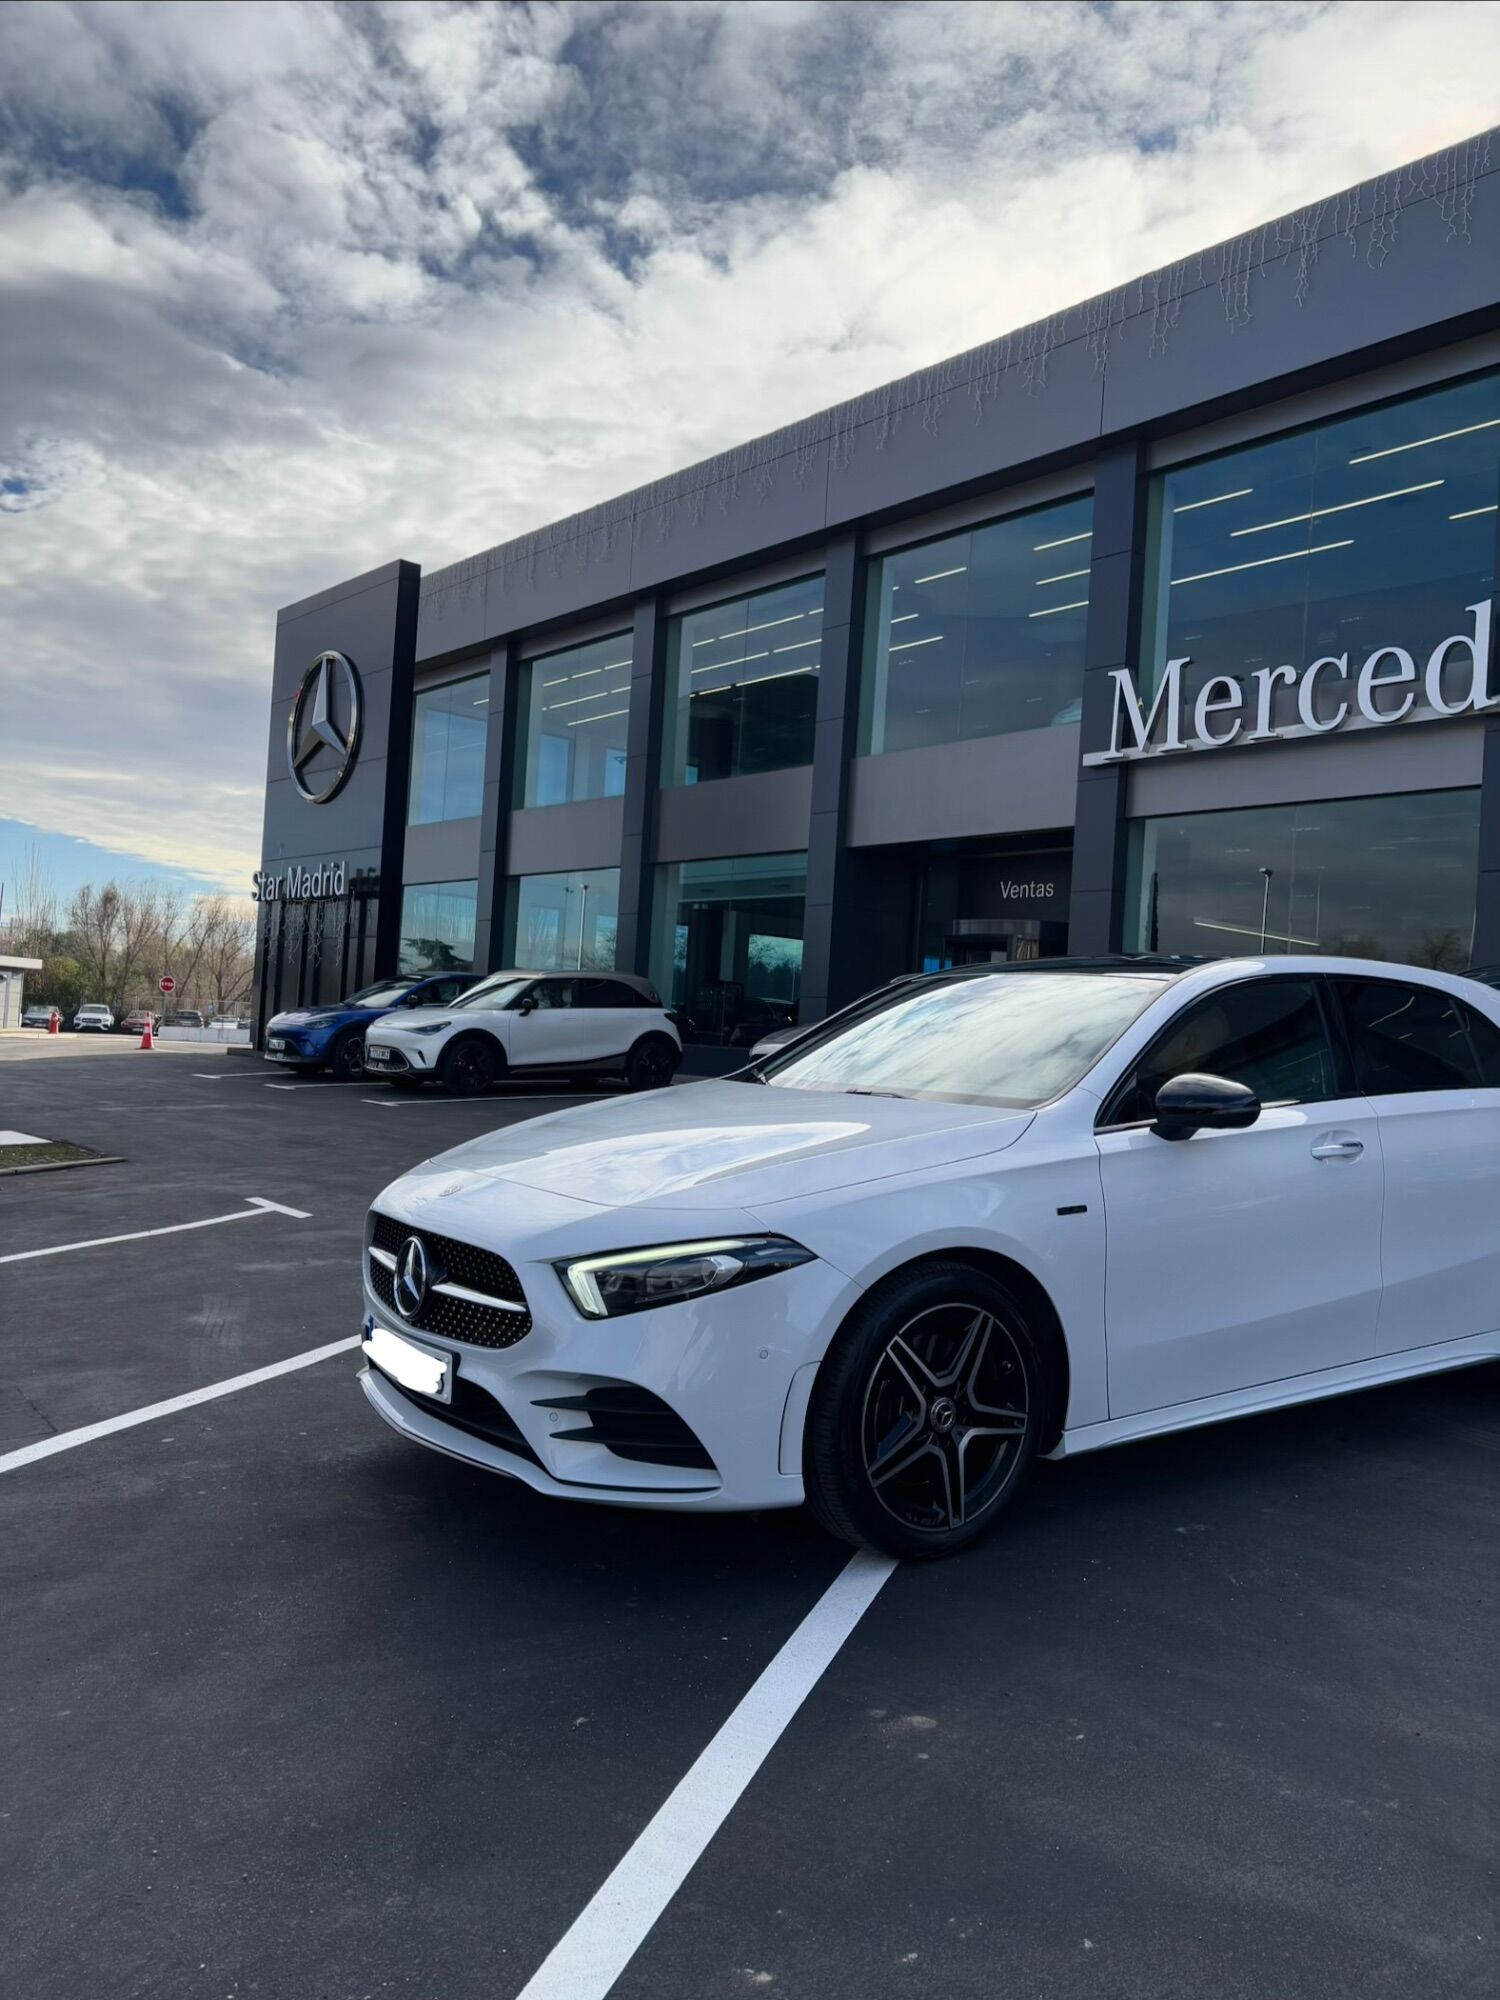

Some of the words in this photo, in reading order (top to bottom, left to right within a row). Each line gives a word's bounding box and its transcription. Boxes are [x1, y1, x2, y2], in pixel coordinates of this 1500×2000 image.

[1102, 599, 1498, 760] Merced
[251, 871, 282, 901] Star
[286, 861, 345, 899] Madrid
[1000, 880, 1054, 899] Ventas
